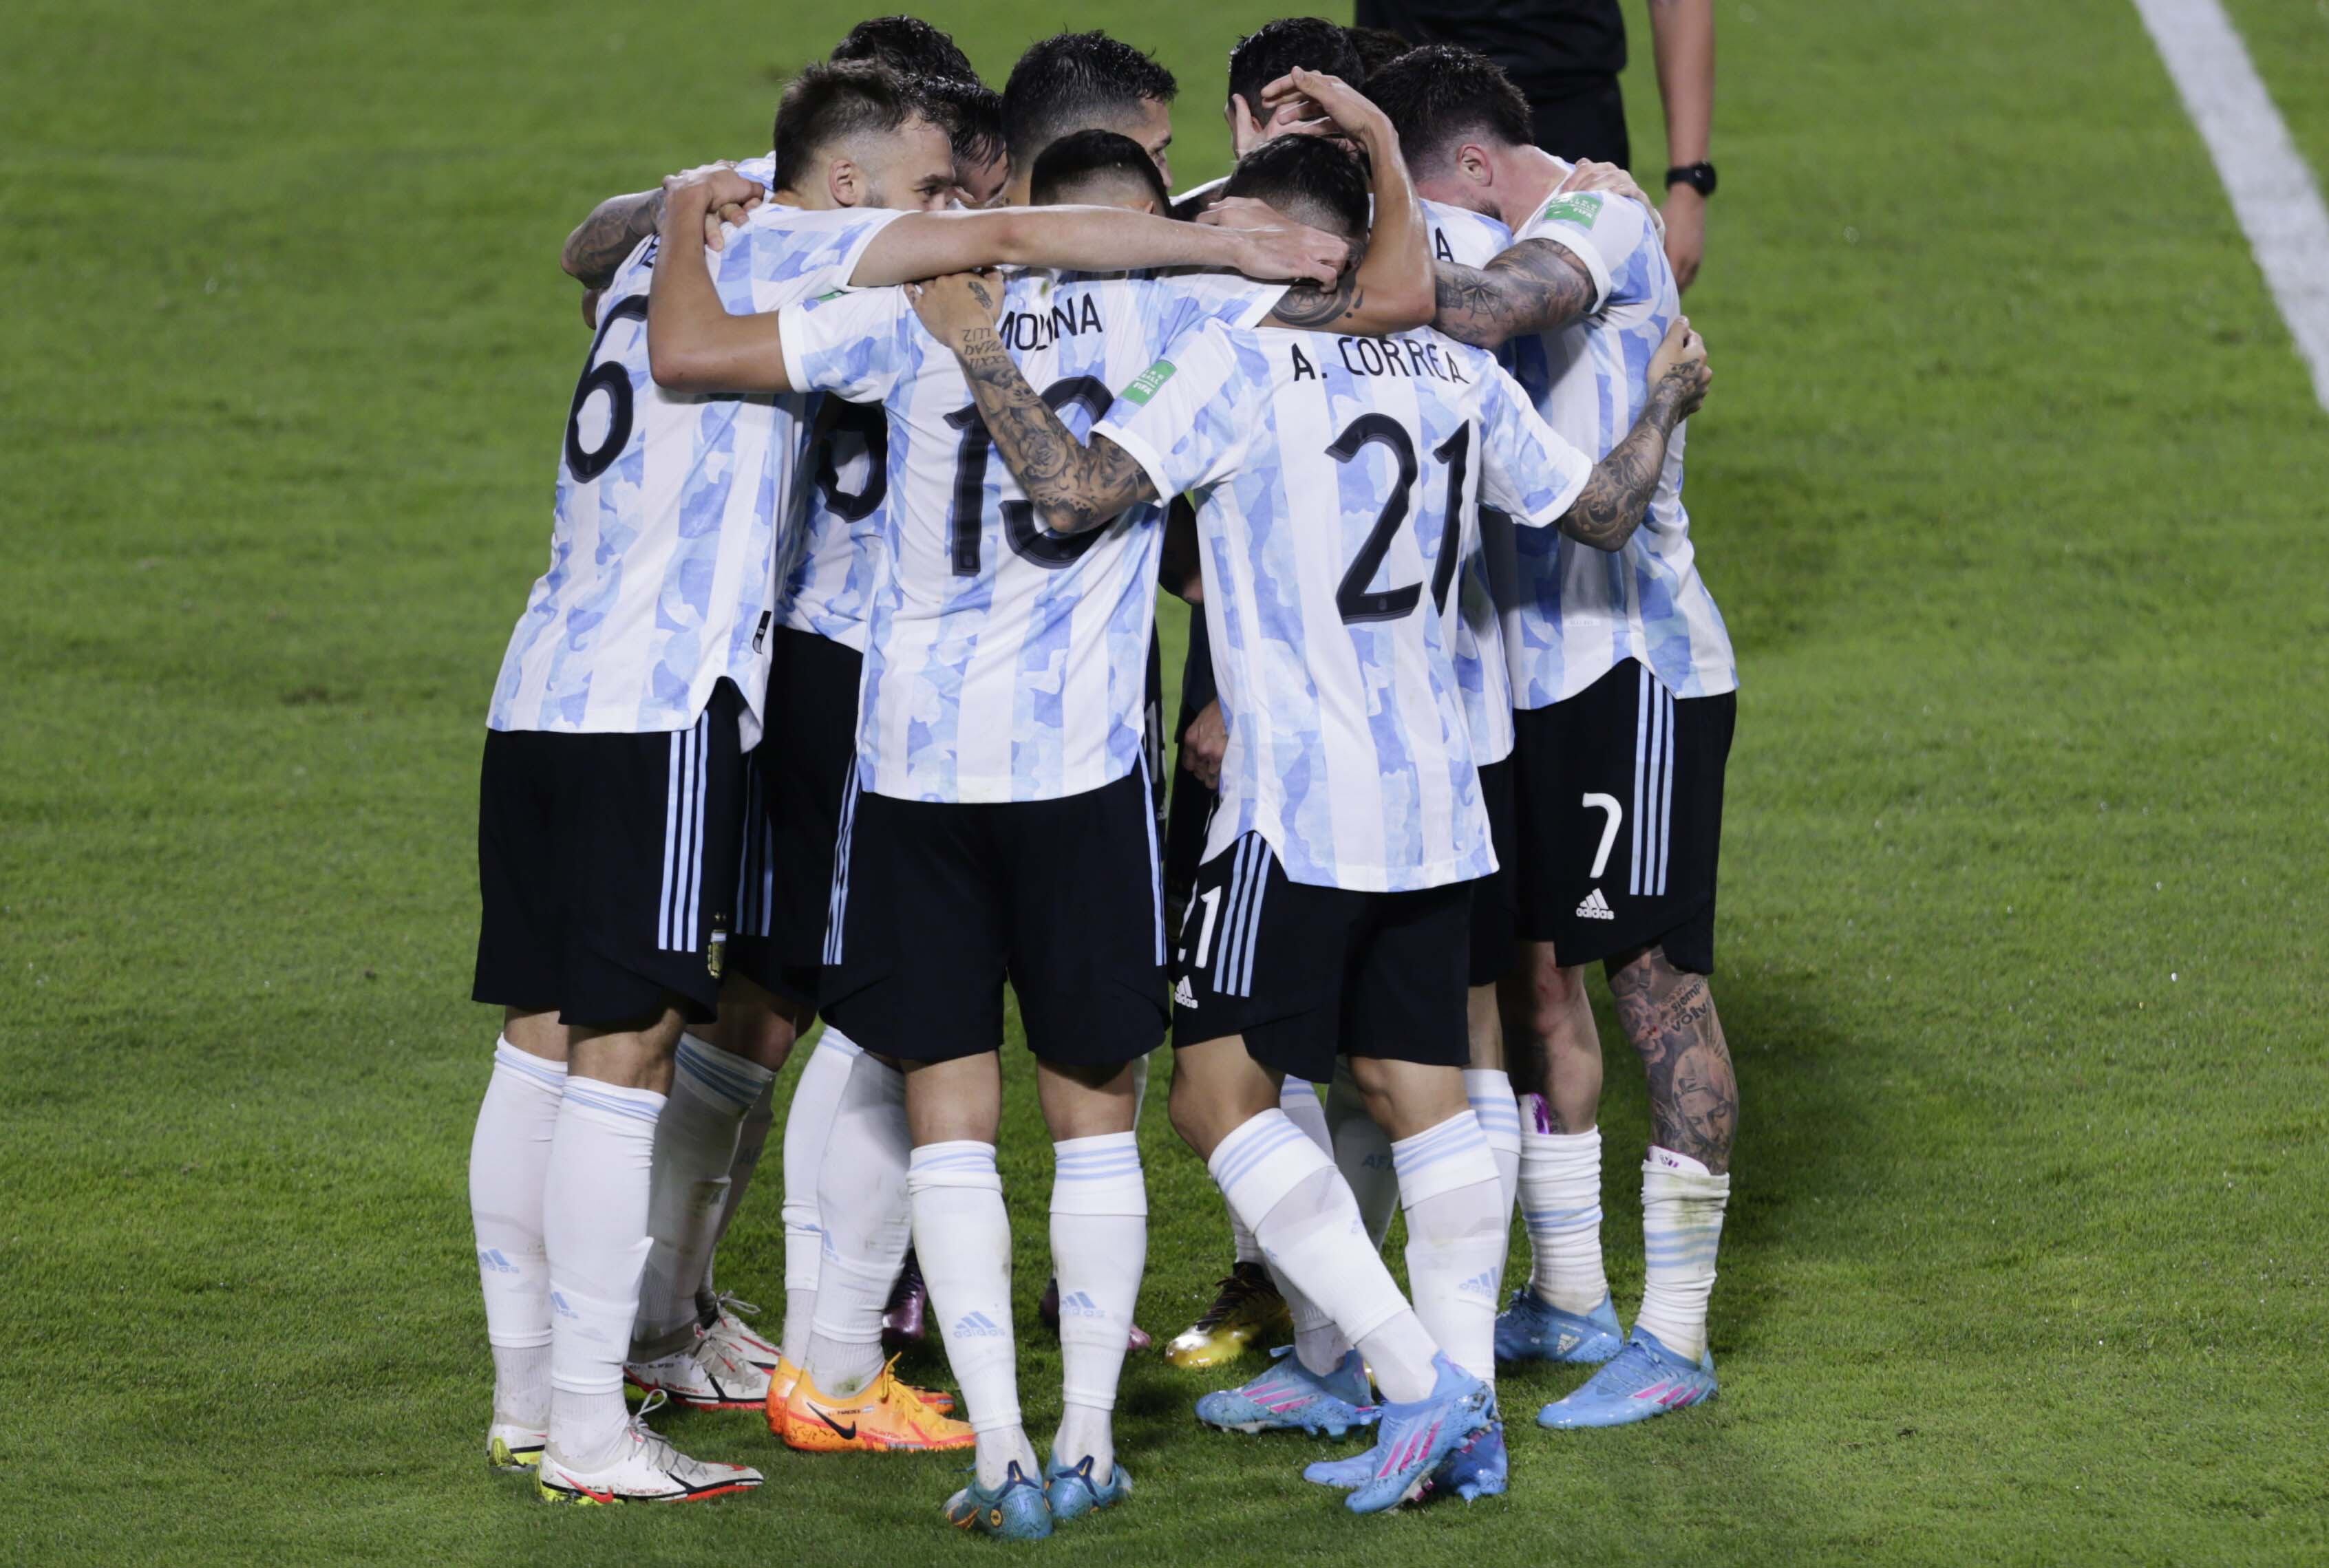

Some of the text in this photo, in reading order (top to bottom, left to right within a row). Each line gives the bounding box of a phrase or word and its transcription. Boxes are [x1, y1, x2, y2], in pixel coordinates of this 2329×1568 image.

[565, 294, 648, 484] 6
[1291, 337, 1470, 384] A. CORREA
[1324, 412, 1470, 625] 21
[1582, 793, 1623, 879] 7
[1576, 907, 1615, 920] adidas
